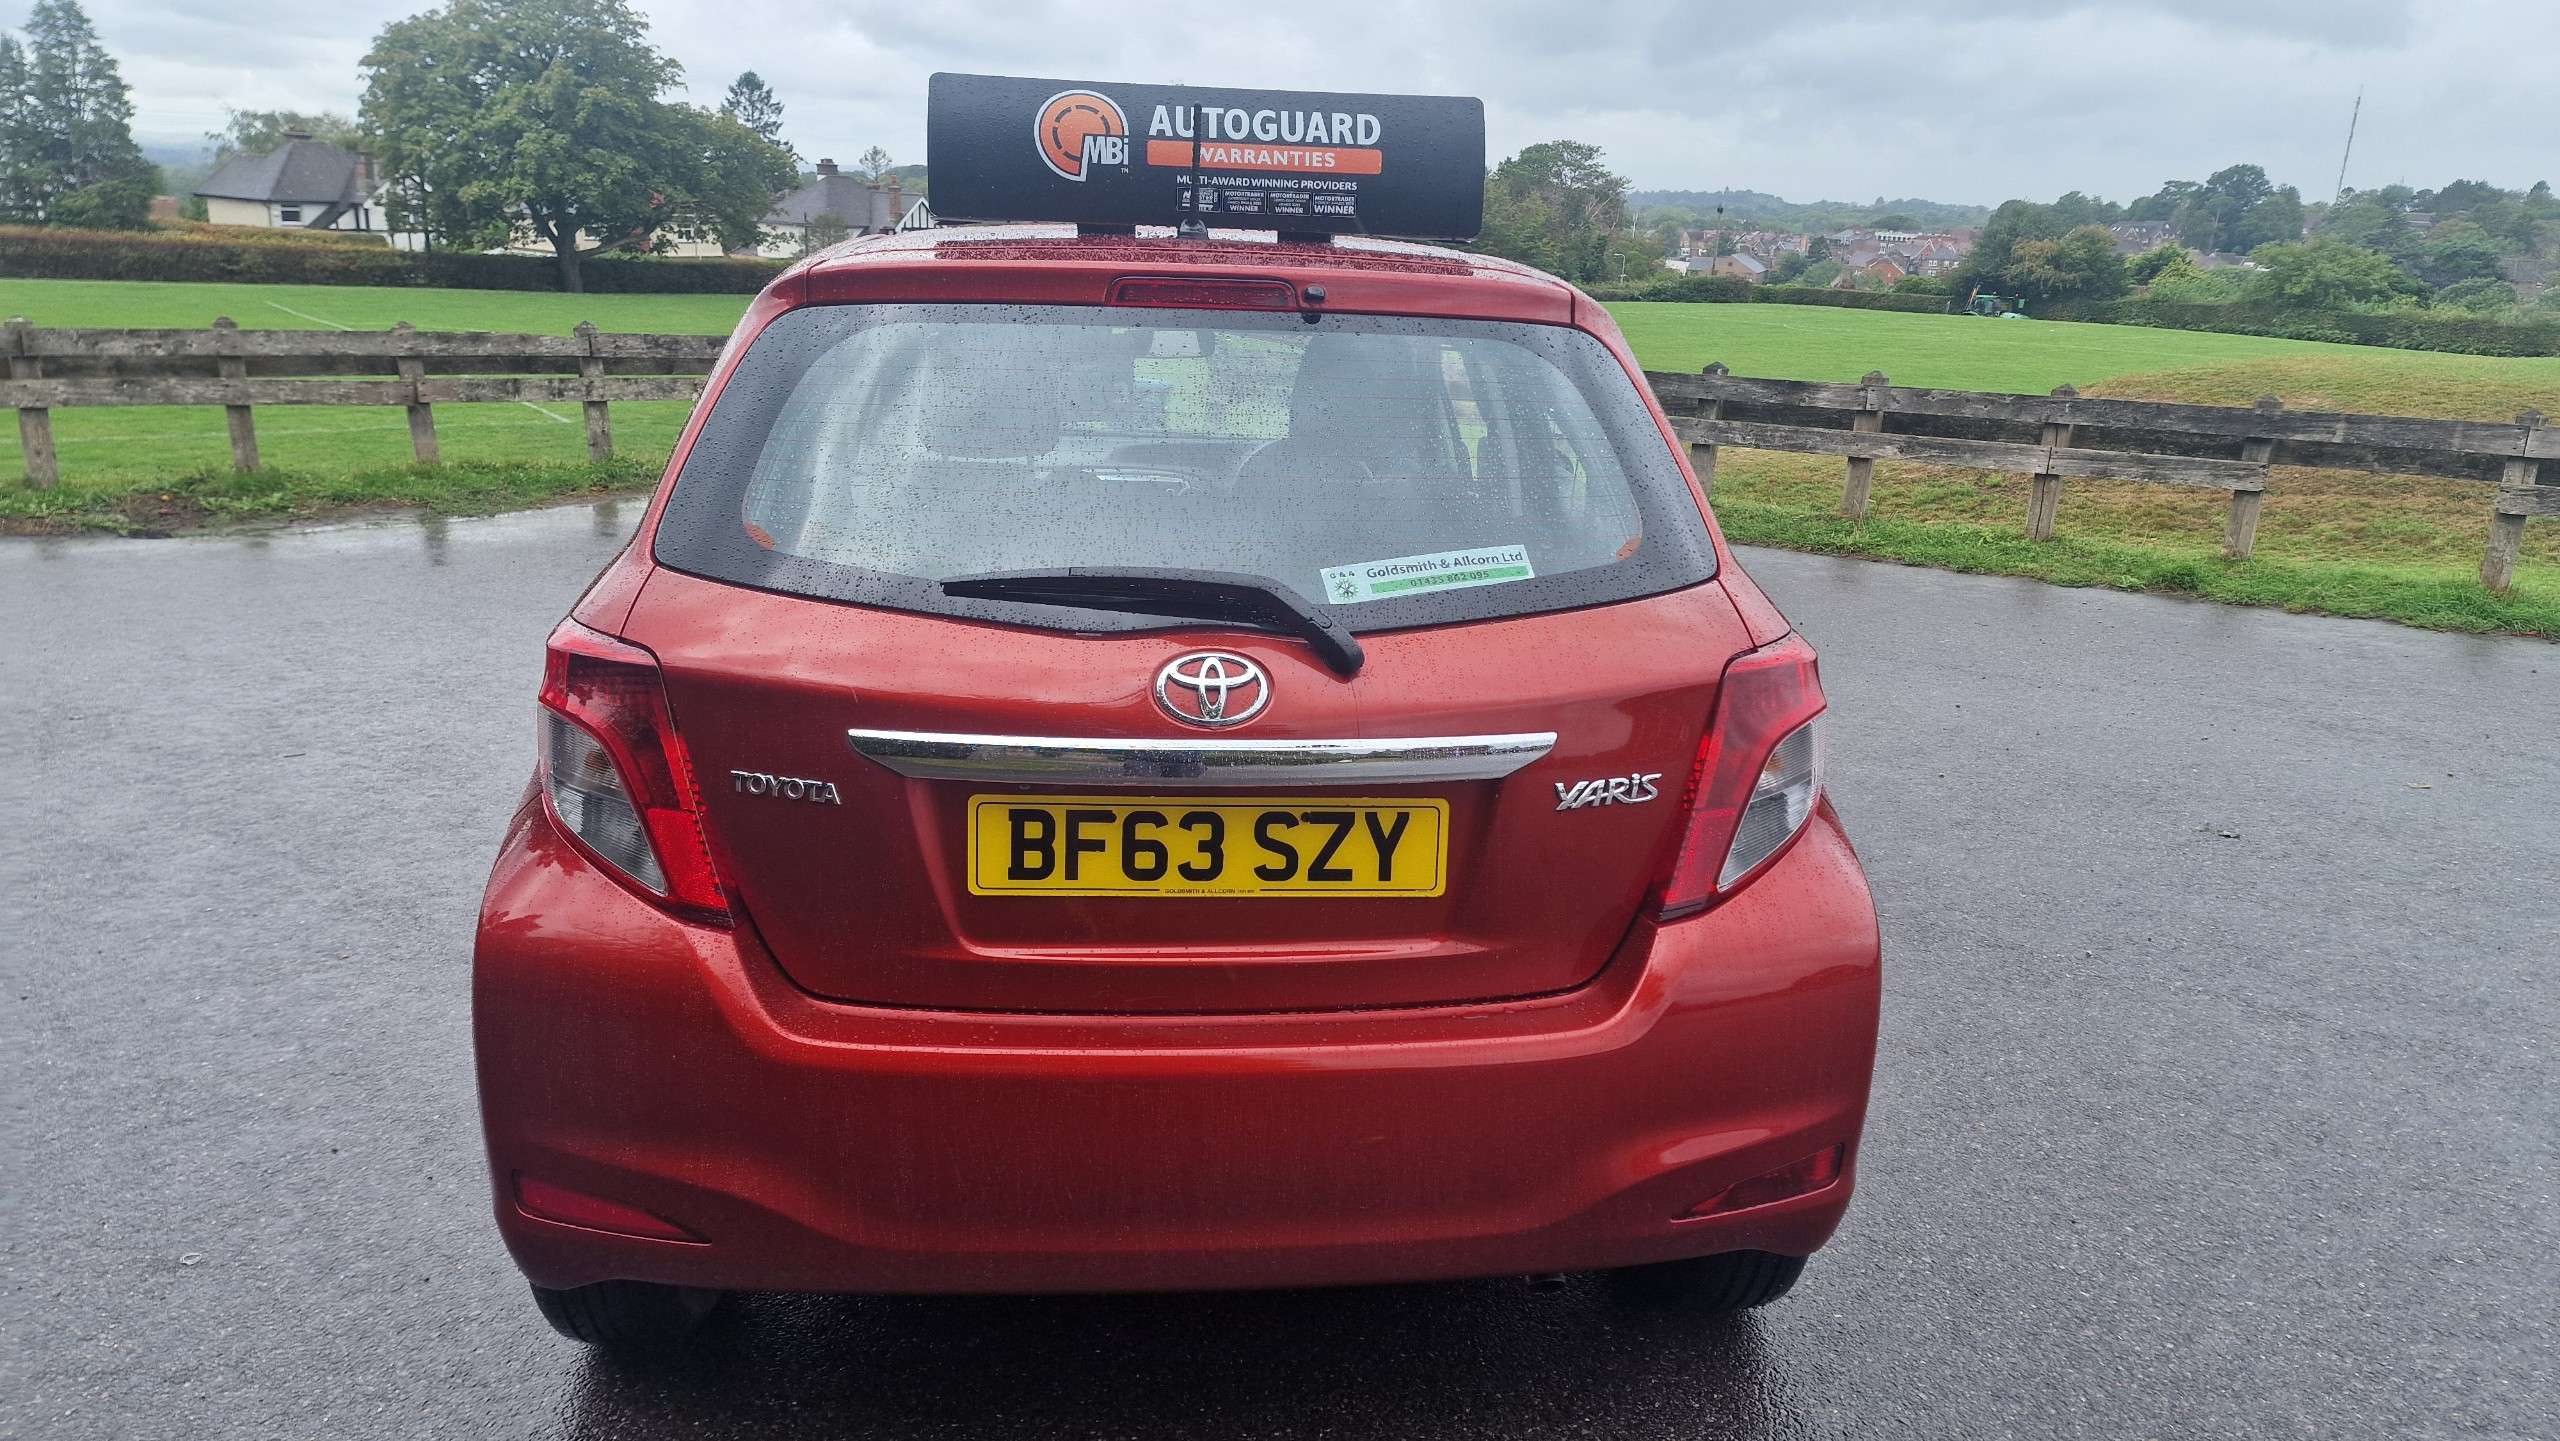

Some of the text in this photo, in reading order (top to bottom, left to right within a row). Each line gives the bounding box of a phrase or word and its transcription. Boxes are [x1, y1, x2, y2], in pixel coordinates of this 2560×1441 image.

[1148, 104, 1382, 146] AUTOGUARD
[1084, 134, 1129, 166] MBi
[1177, 175, 1358, 191] MUTI-AWARD WINNING PROVIDERS
[1229, 204, 1259, 212] WINNER
[1275, 206, 1304, 214] WINNER
[1314, 204, 1355, 215] WINNER
[1366, 551, 1524, 579] Goldsmith & Allcorn Ltd
[730, 769, 842, 806] TOYOTA
[1007, 808, 1411, 883] BF63 SZY
